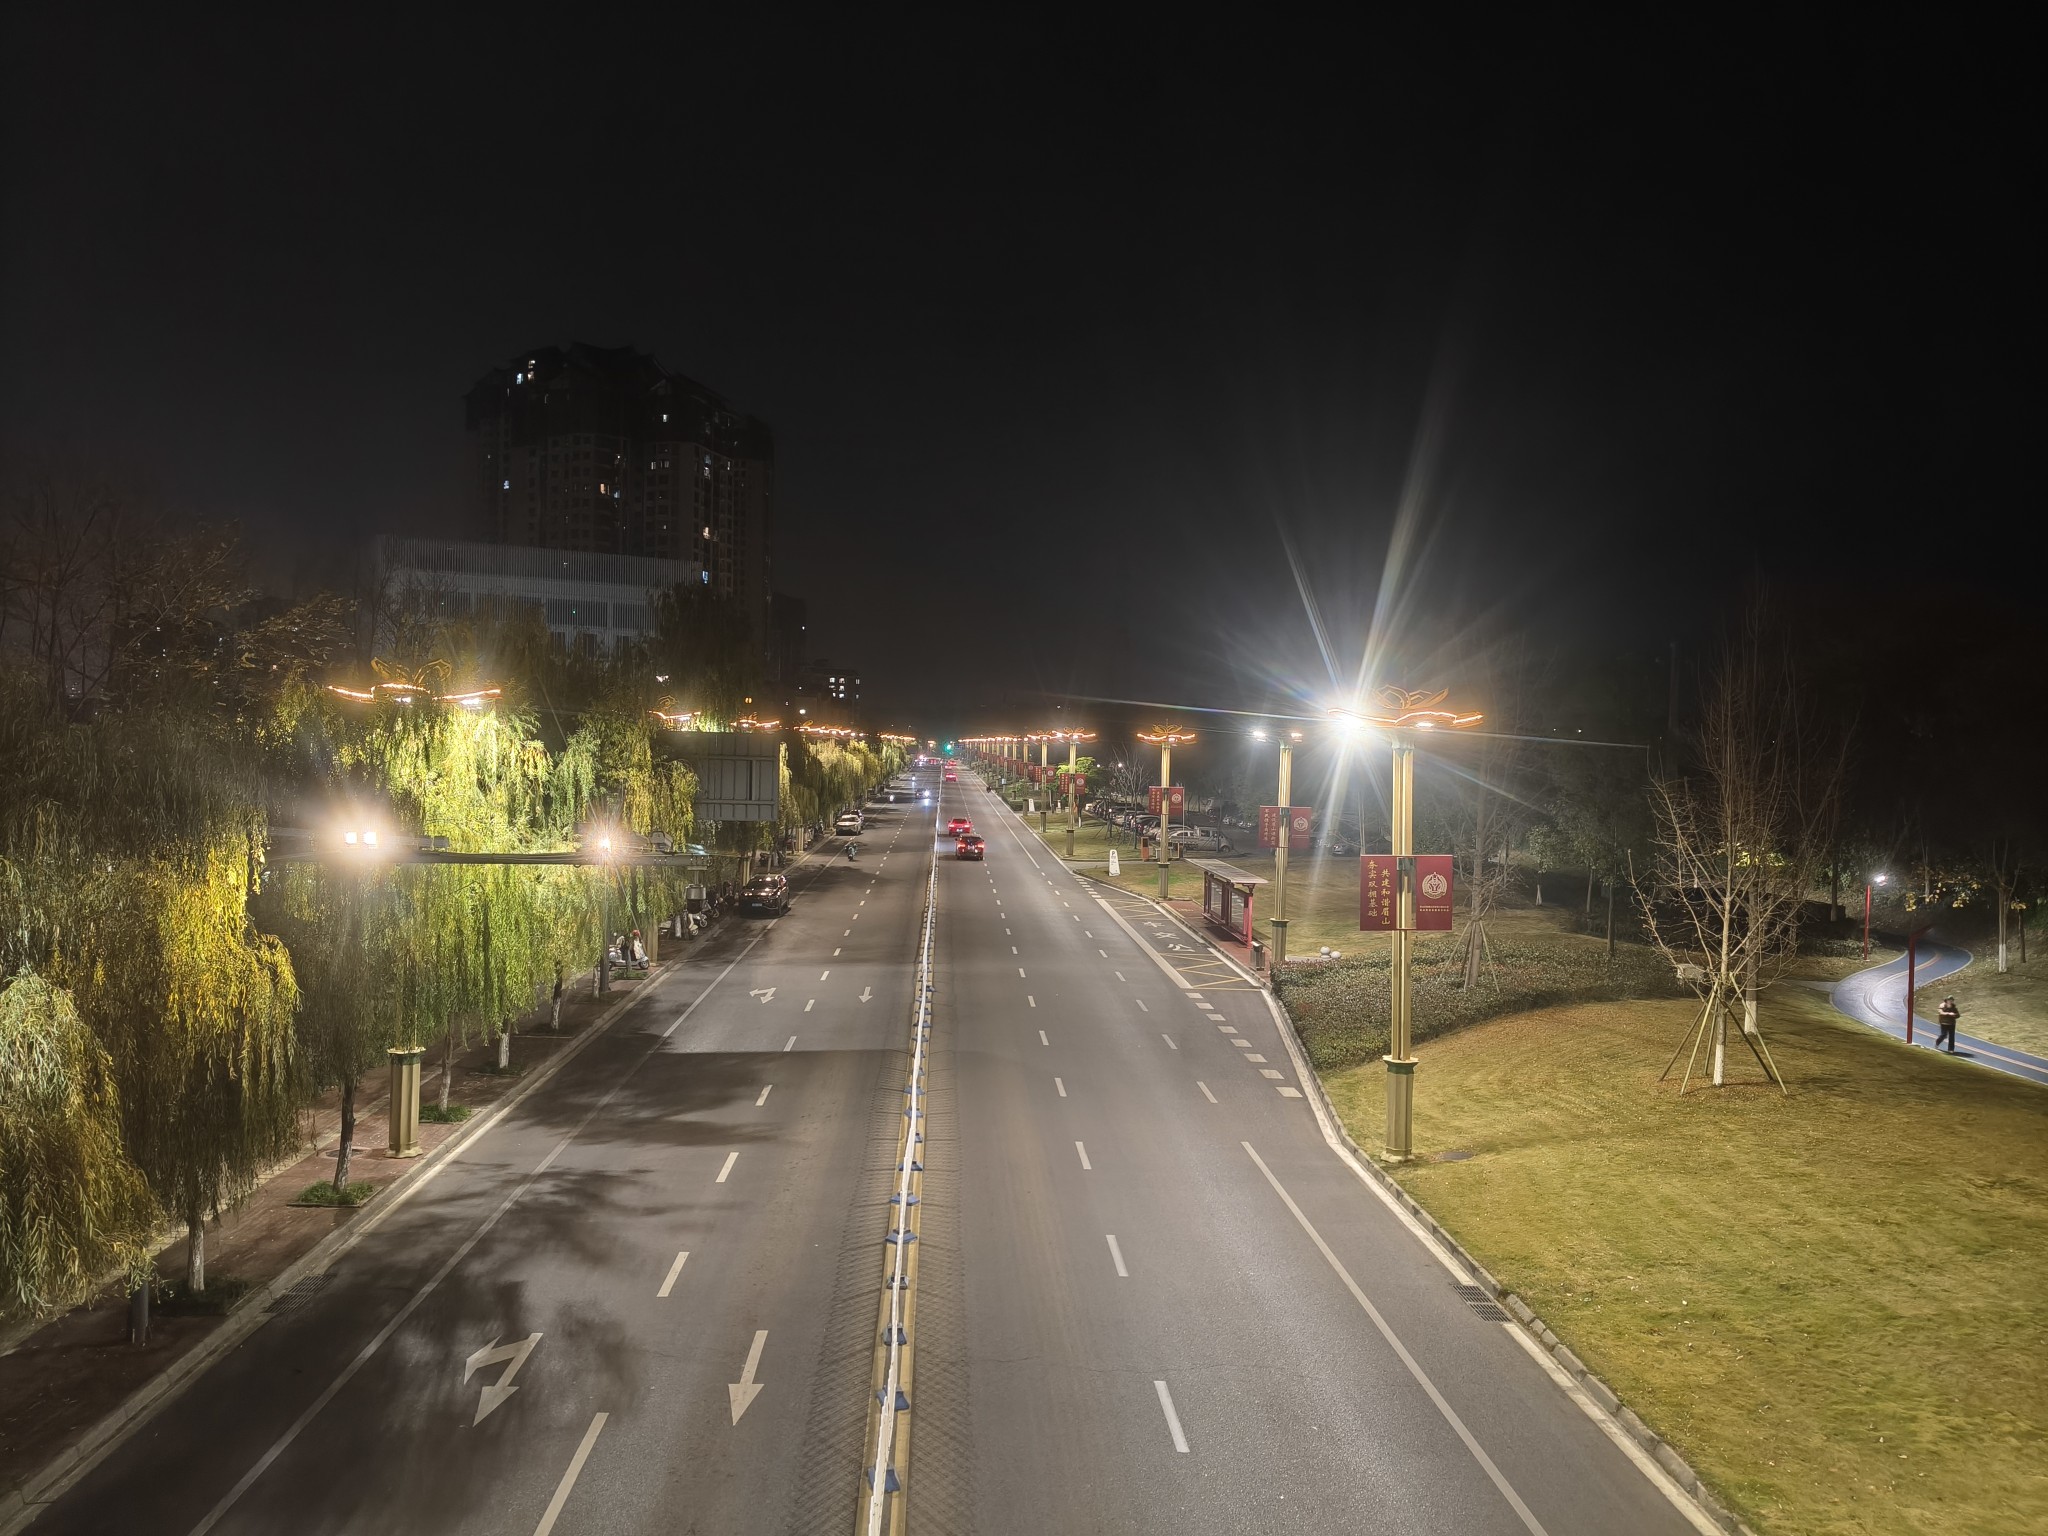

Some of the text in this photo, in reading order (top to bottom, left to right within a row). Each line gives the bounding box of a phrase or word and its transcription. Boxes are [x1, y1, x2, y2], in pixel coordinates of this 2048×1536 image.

[1380, 868, 1391, 925] 共建和谐眉山
